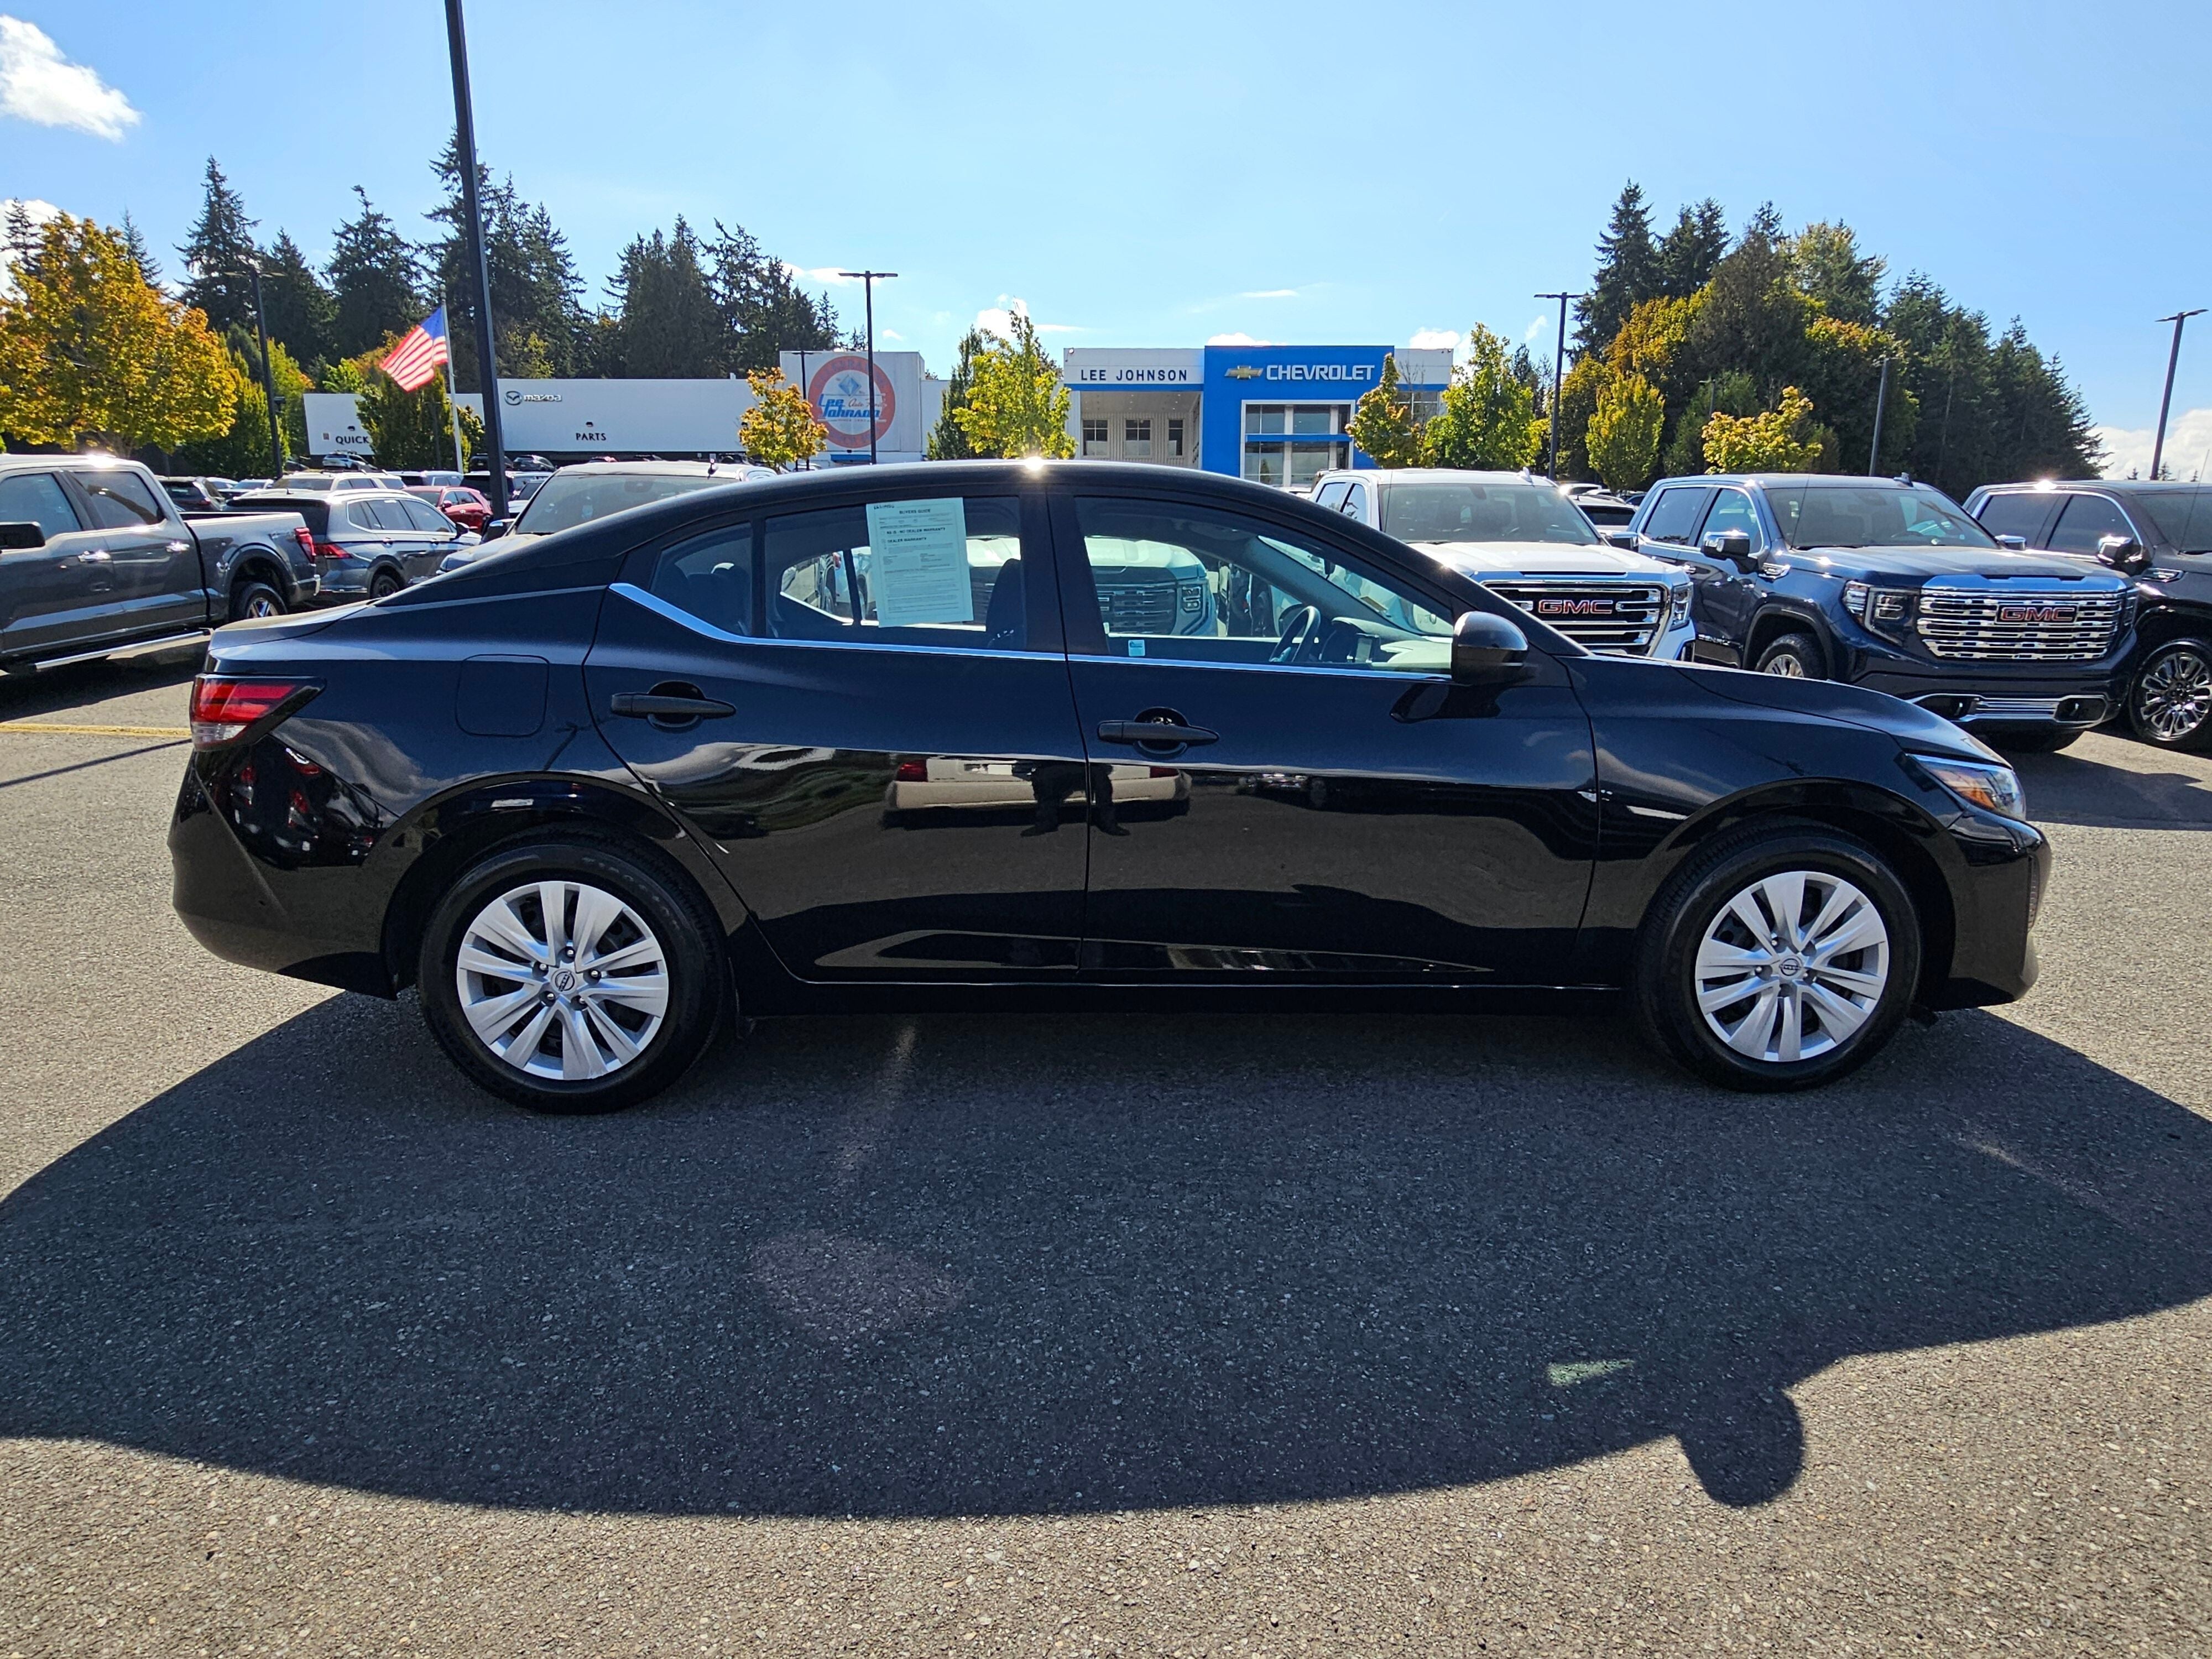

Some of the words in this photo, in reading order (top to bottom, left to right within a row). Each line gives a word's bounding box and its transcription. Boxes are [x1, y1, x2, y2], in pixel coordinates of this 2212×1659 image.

[1081, 369, 1107, 381] LEE
[1116, 369, 1187, 381] JOHNSON
[1266, 364, 1375, 380] CHEVROLET
[817, 394, 844, 407] Lee
[335, 436, 369, 445] QUICK
[576, 432, 607, 441] PARTS
[1538, 599, 1613, 614] GMC
[2000, 607, 2075, 621] GMC
